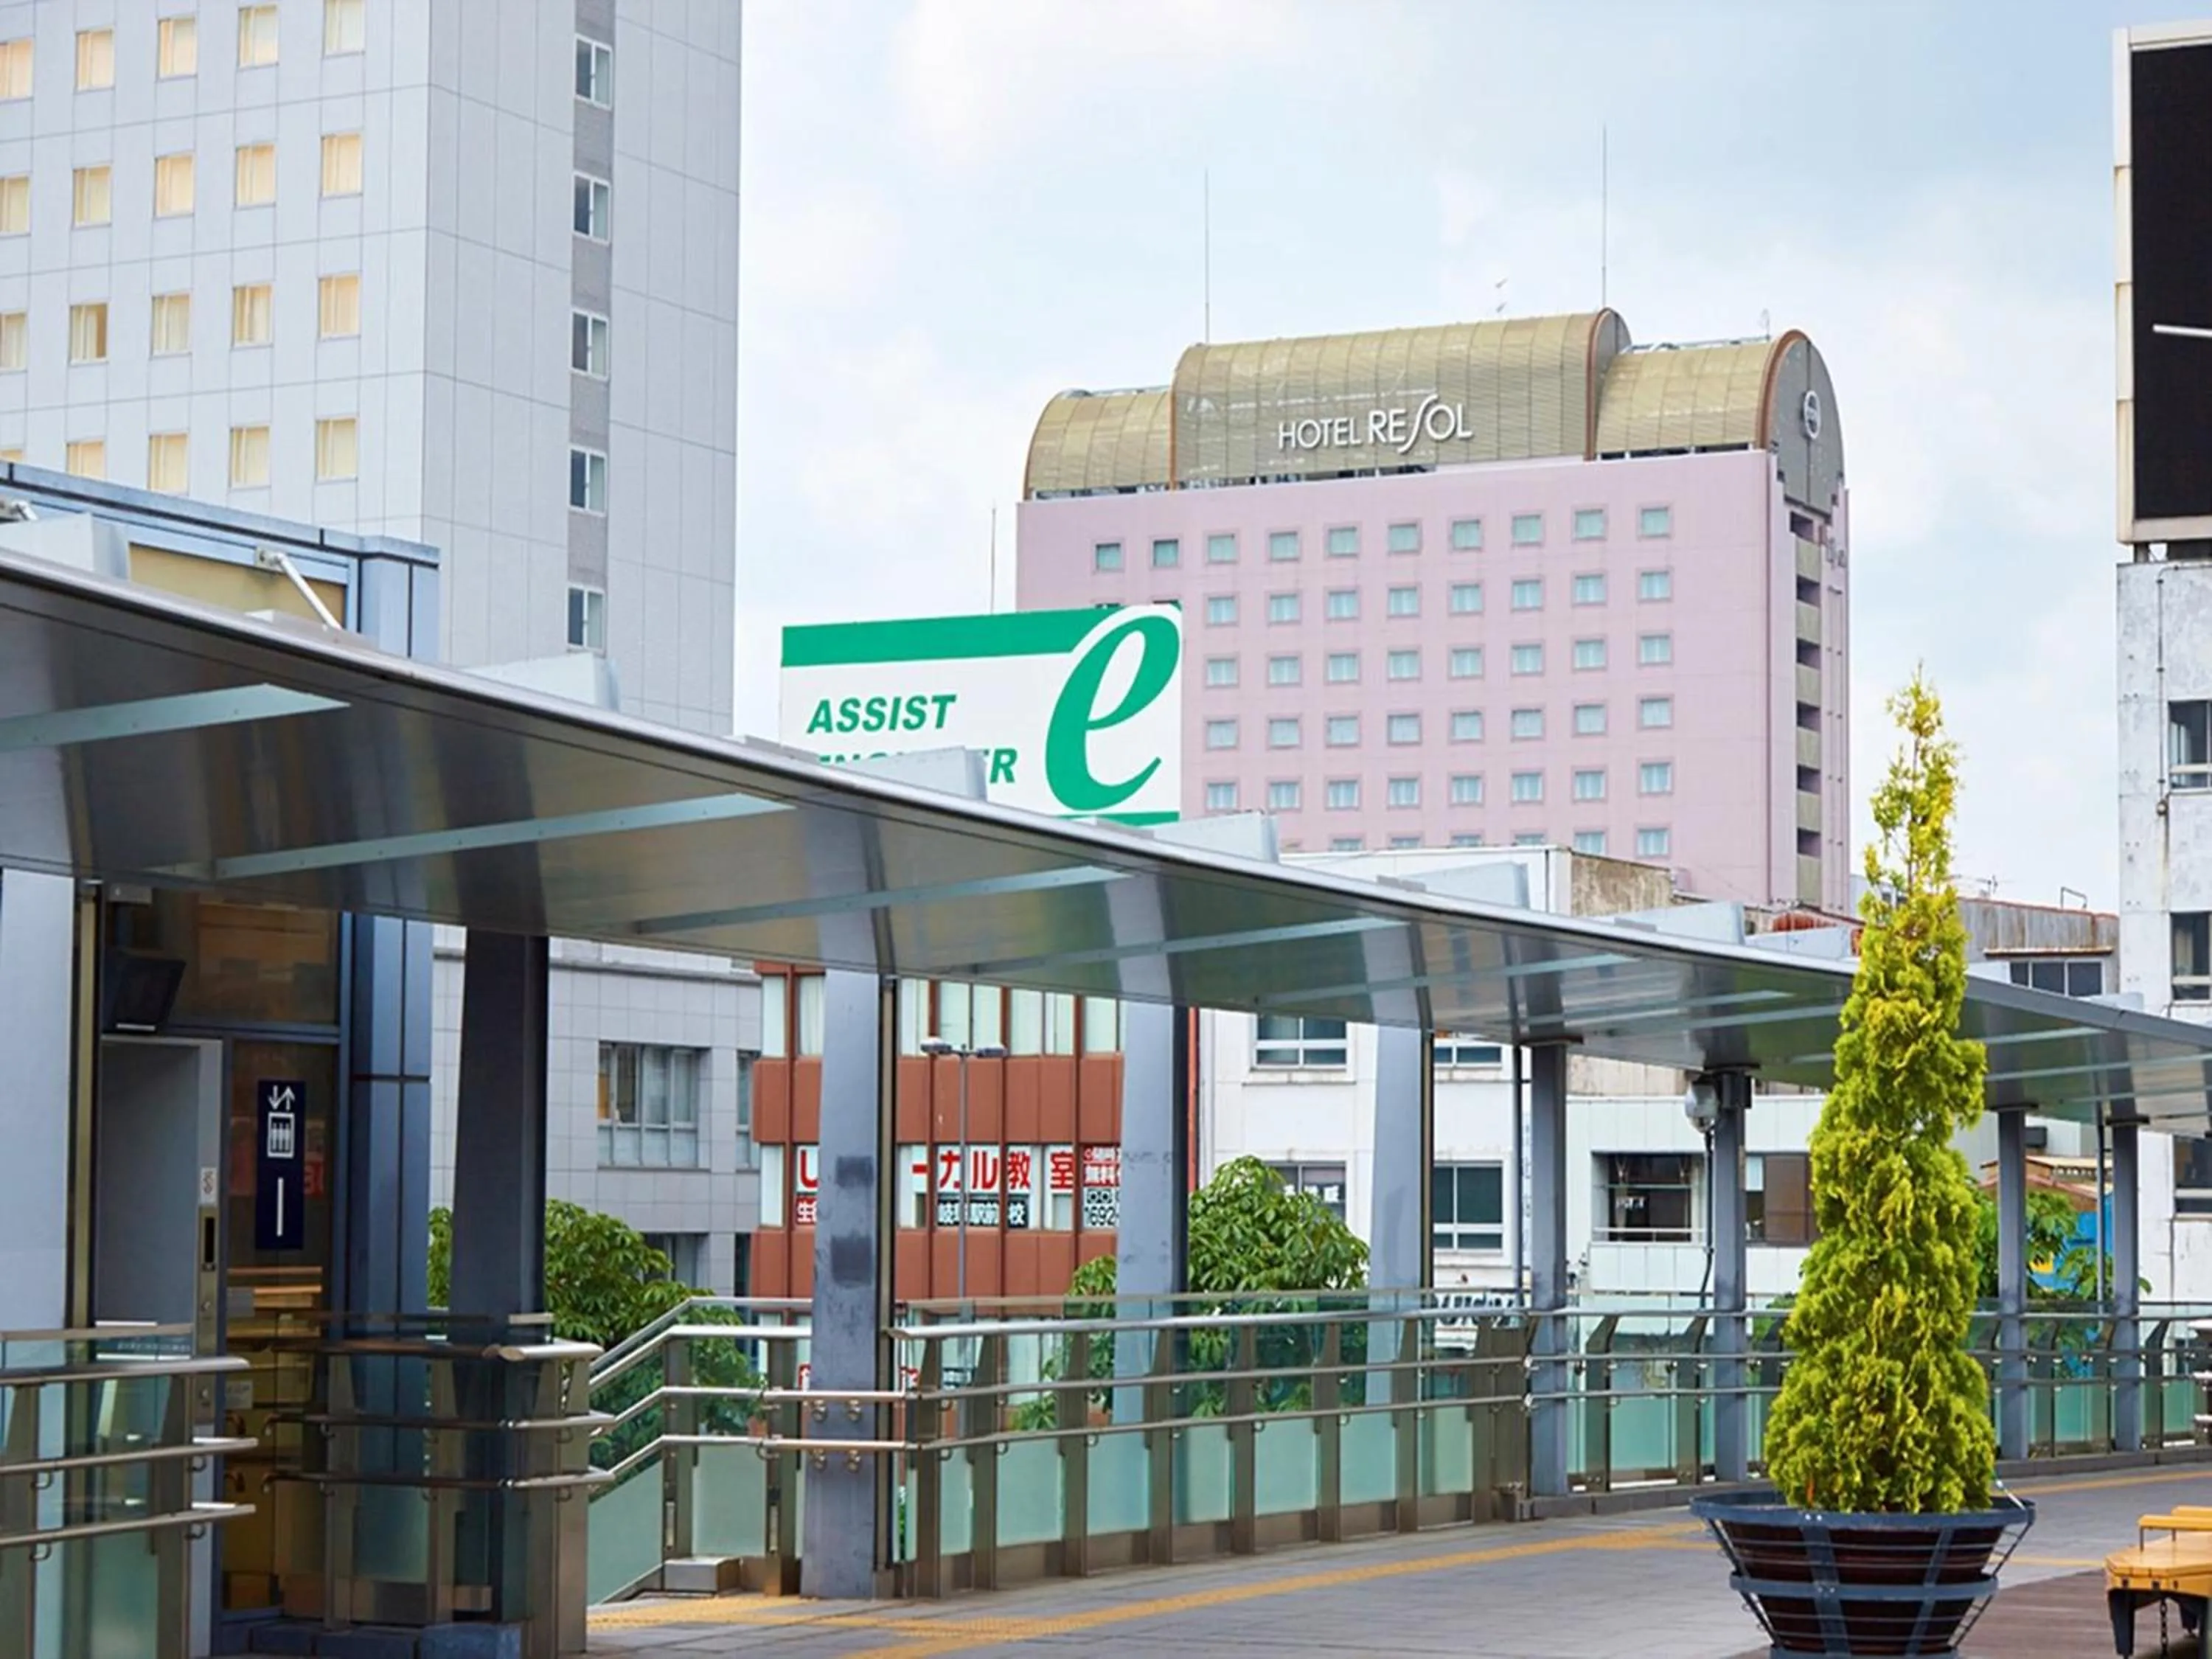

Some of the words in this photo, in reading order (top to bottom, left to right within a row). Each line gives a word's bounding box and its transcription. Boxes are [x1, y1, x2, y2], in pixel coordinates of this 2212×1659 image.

[1278, 417, 1362, 449] HOTEL
[1368, 393, 1473, 453] RESOL
[807, 695, 956, 734] ASSIST
[1046, 615, 1180, 811] e
